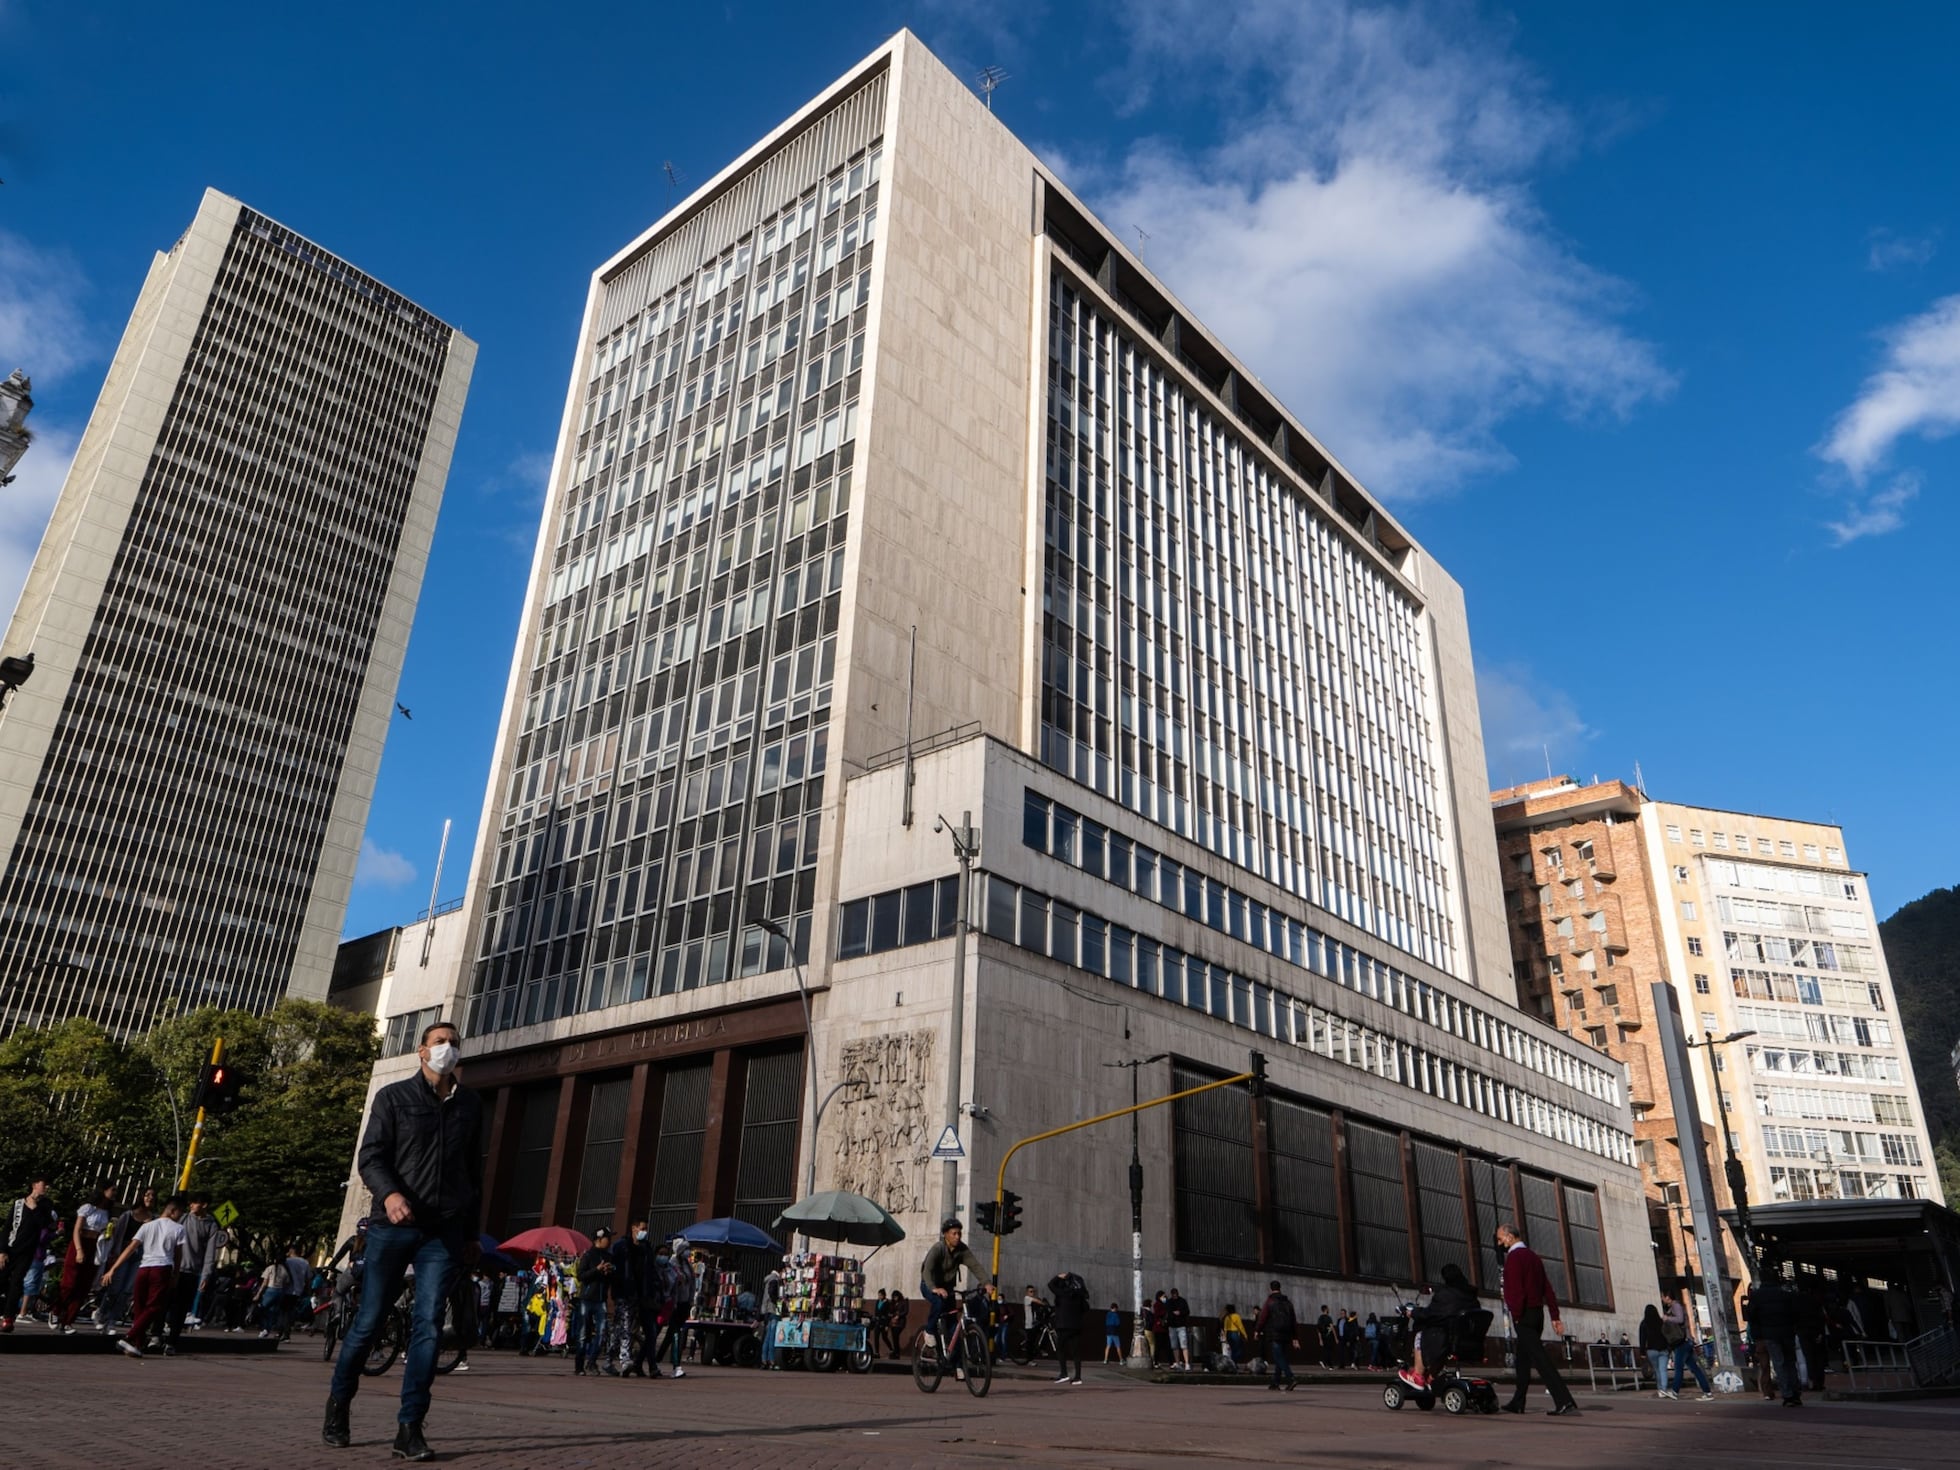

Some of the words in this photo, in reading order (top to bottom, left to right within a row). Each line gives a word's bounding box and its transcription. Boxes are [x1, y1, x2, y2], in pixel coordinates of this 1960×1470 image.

[568, 1043, 586, 1063] DE
[597, 1038, 619, 1057] LA
[631, 1017, 727, 1050] REPUBLICA
